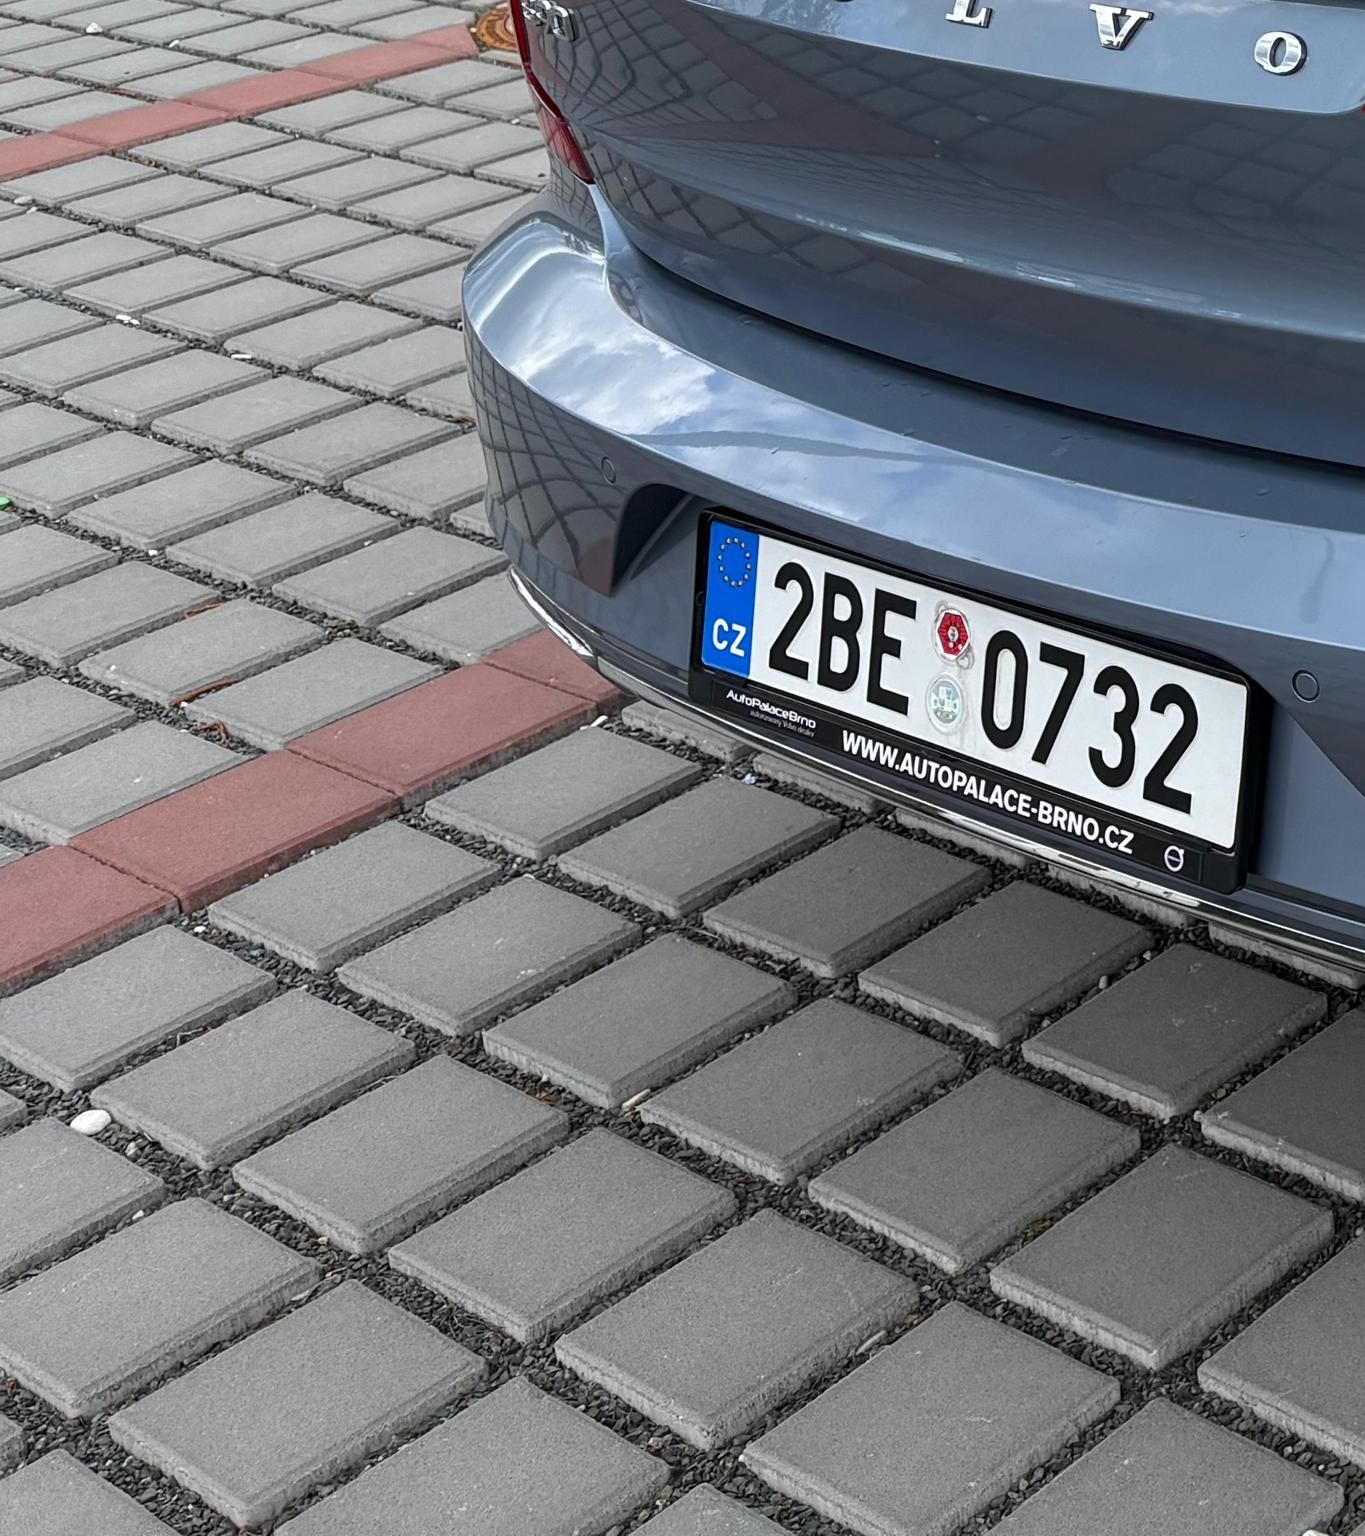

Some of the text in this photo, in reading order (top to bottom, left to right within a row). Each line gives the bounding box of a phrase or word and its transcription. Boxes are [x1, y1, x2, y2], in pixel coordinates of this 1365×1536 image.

[711, 618, 746, 658] CZ
[726, 690, 816, 729] AutoPalaceBrno
[769, 561, 1199, 815] 2BE 0732
[842, 730, 1134, 855] WWW.AUTOPALACE-BRNO.CZ
